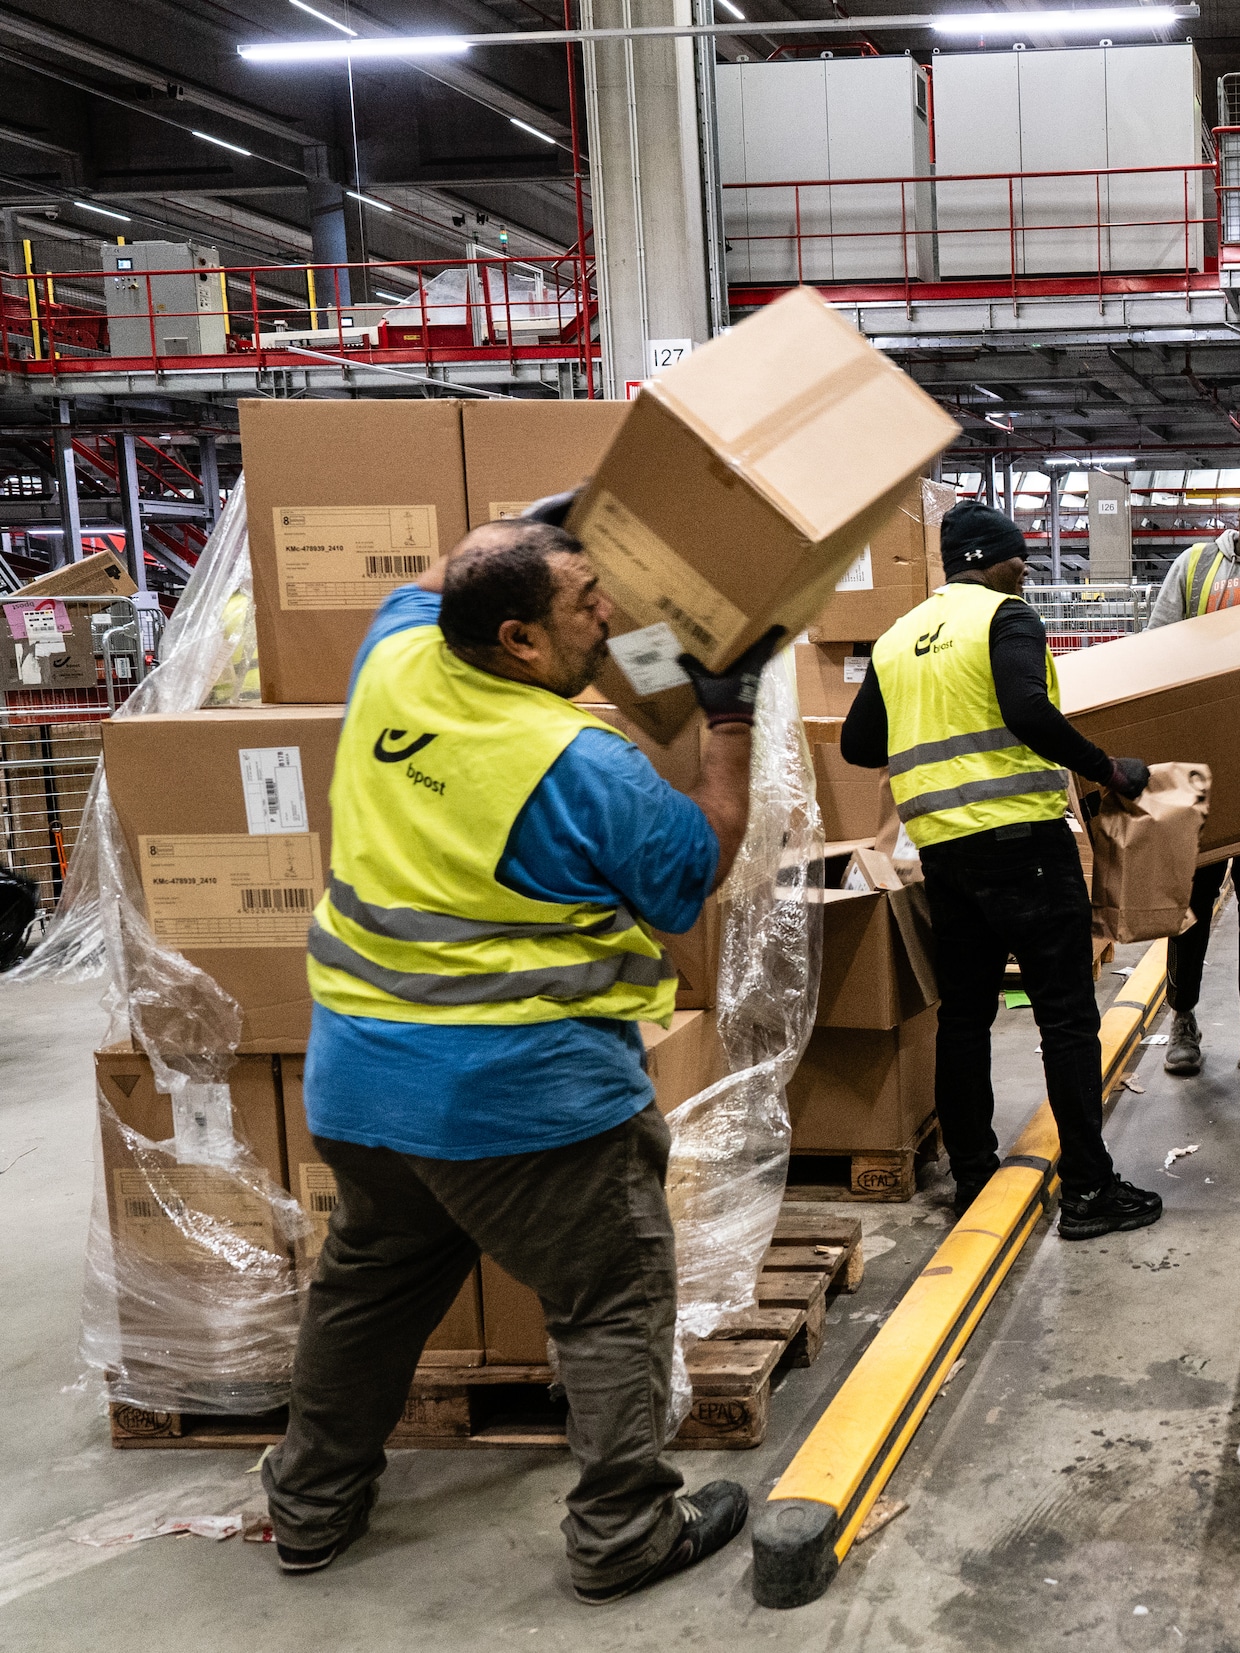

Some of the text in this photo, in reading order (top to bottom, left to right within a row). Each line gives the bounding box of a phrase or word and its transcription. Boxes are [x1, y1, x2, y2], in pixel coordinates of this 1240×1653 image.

[283, 516, 290, 526] 8
[12, 601, 35, 610] bpost
[933, 640, 953, 654] bost
[406, 762, 446, 796] bpost
[150, 845, 157, 855] 8
[863, 1174, 891, 1187] EPAL
